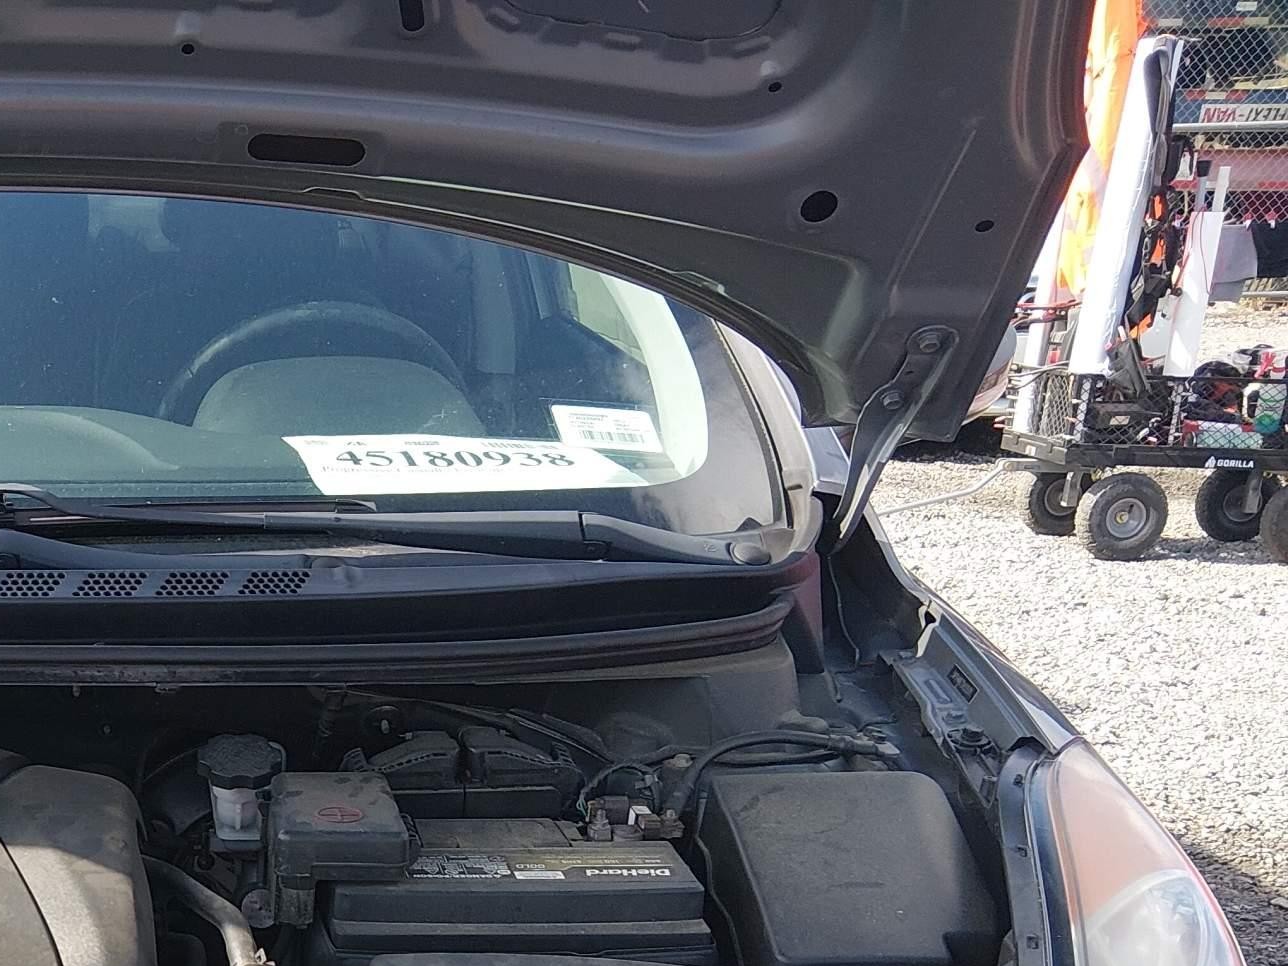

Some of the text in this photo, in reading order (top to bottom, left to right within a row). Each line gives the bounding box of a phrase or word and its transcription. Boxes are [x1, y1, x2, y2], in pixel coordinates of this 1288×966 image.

[336, 450, 575, 468] 45180938
[1217, 459, 1254, 468] GORILLA
[586, 868, 671, 877] DieHard
